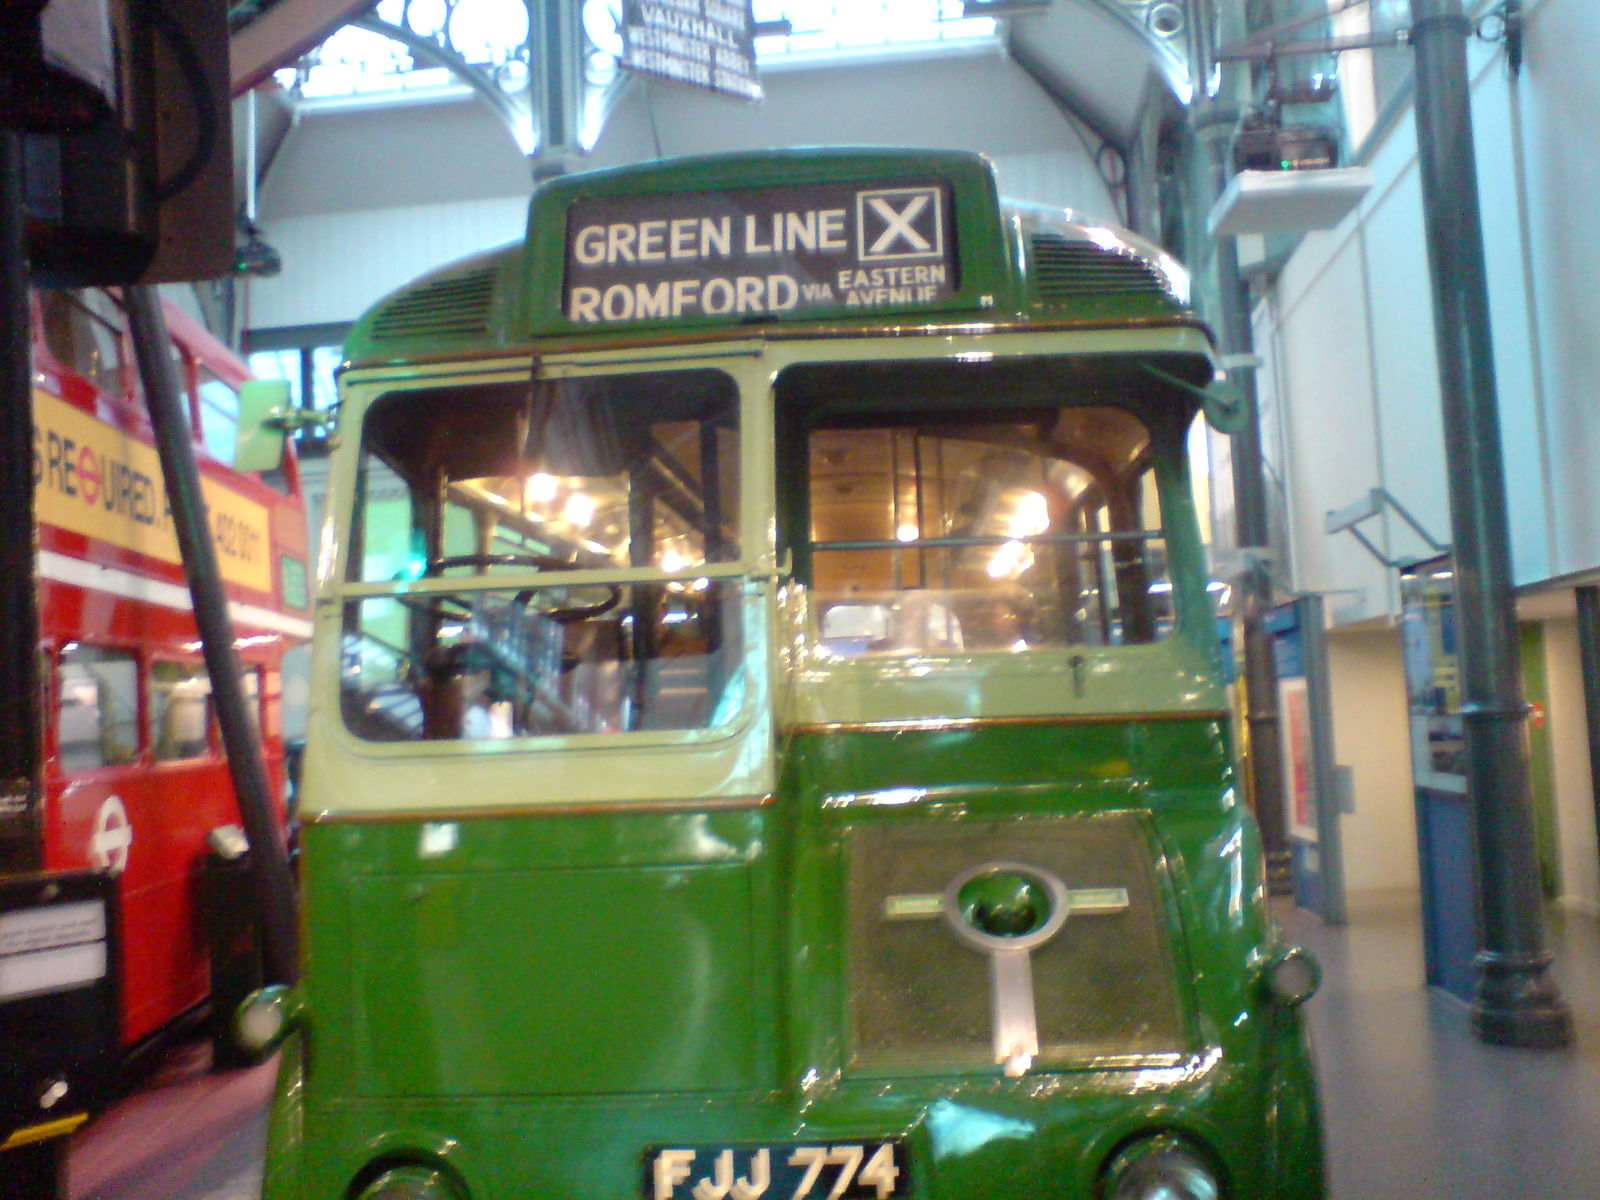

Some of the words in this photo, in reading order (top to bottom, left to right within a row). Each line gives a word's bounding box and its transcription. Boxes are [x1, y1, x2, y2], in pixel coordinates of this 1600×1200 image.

[575, 216, 731, 266] GREEN
[745, 210, 847, 254] LINE
[867, 195, 933, 252] X
[570, 275, 799, 322] ROMFORD
[802, 283, 833, 300] VIA
[838, 264, 945, 289] EASTERN
[653, 1148, 771, 1200] FJJ
[788, 1143, 900, 1200] 774
